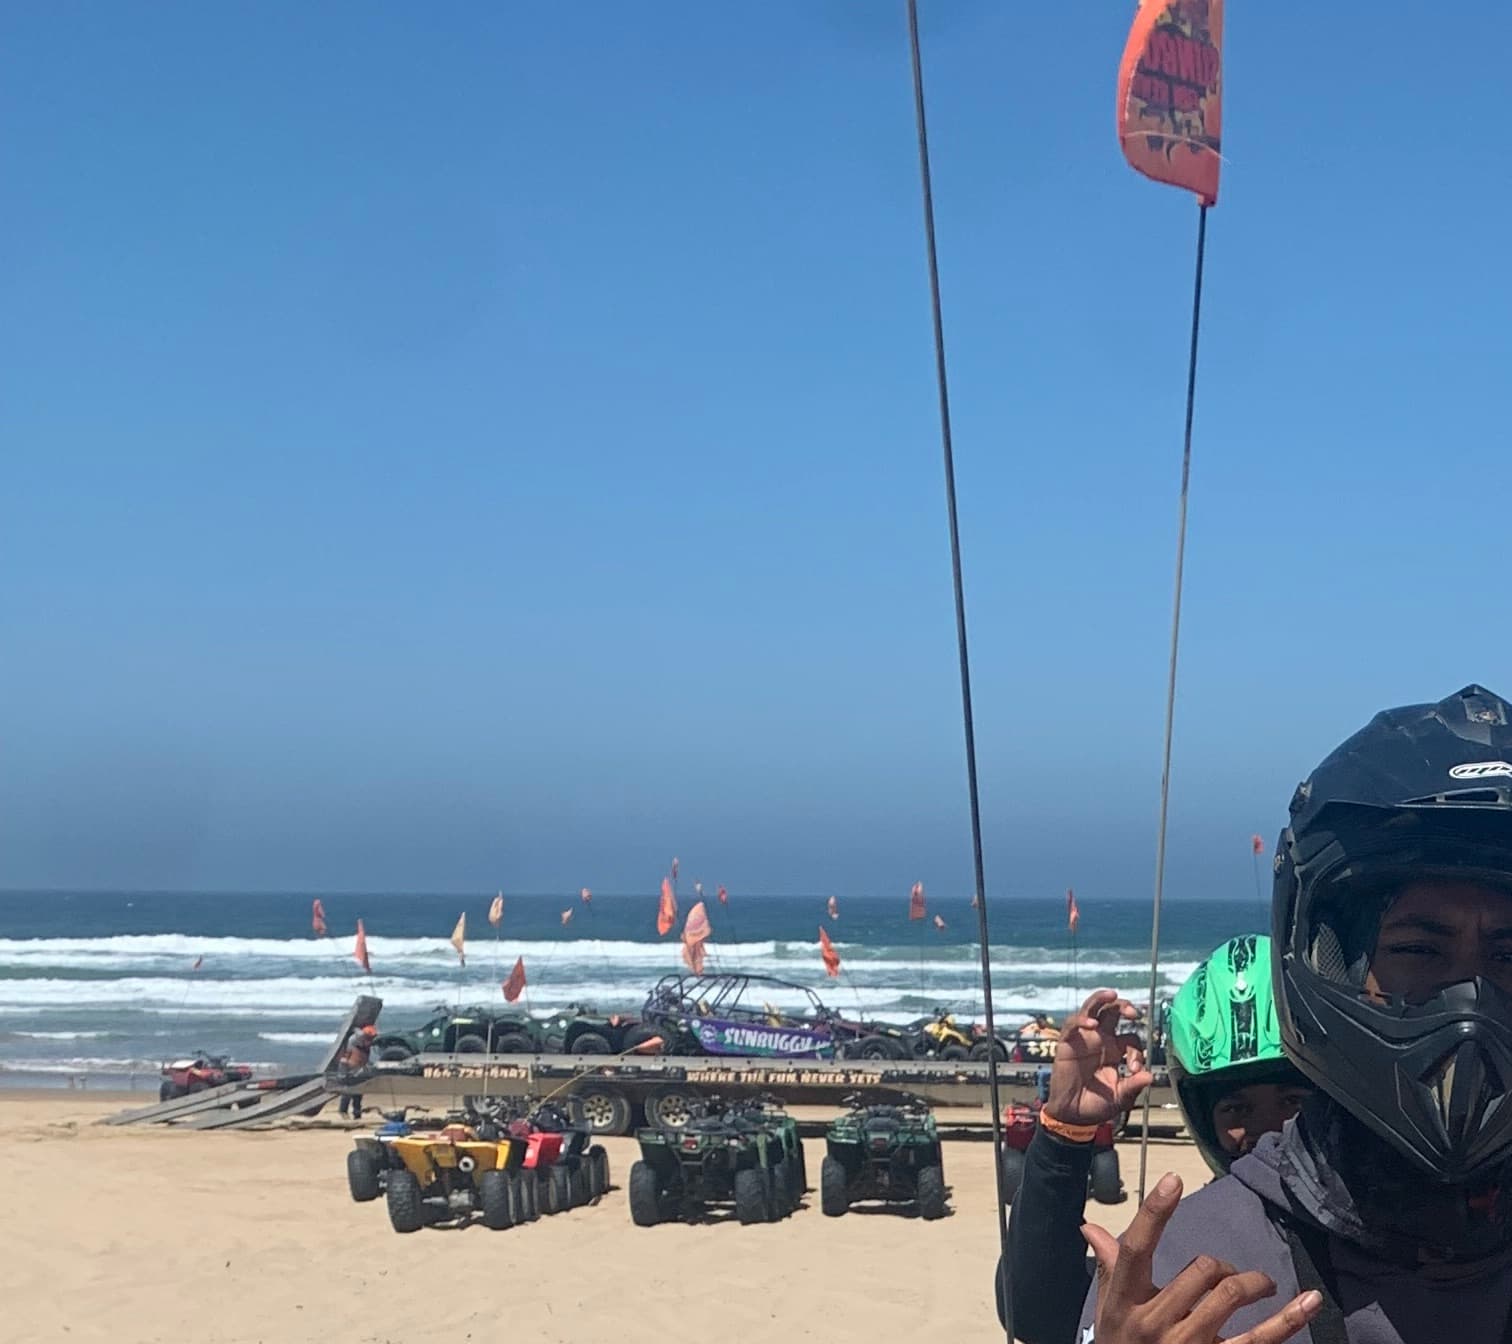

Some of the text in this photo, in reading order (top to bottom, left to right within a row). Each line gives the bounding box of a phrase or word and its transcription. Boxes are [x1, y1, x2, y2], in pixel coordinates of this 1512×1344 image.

[724, 1028, 813, 1052] SUNBUGGY
[686, 1071, 736, 1082] WHERE
[740, 1071, 764, 1083] THE
[768, 1072, 797, 1083] FUN
[800, 1072, 845, 1084] NEVER
